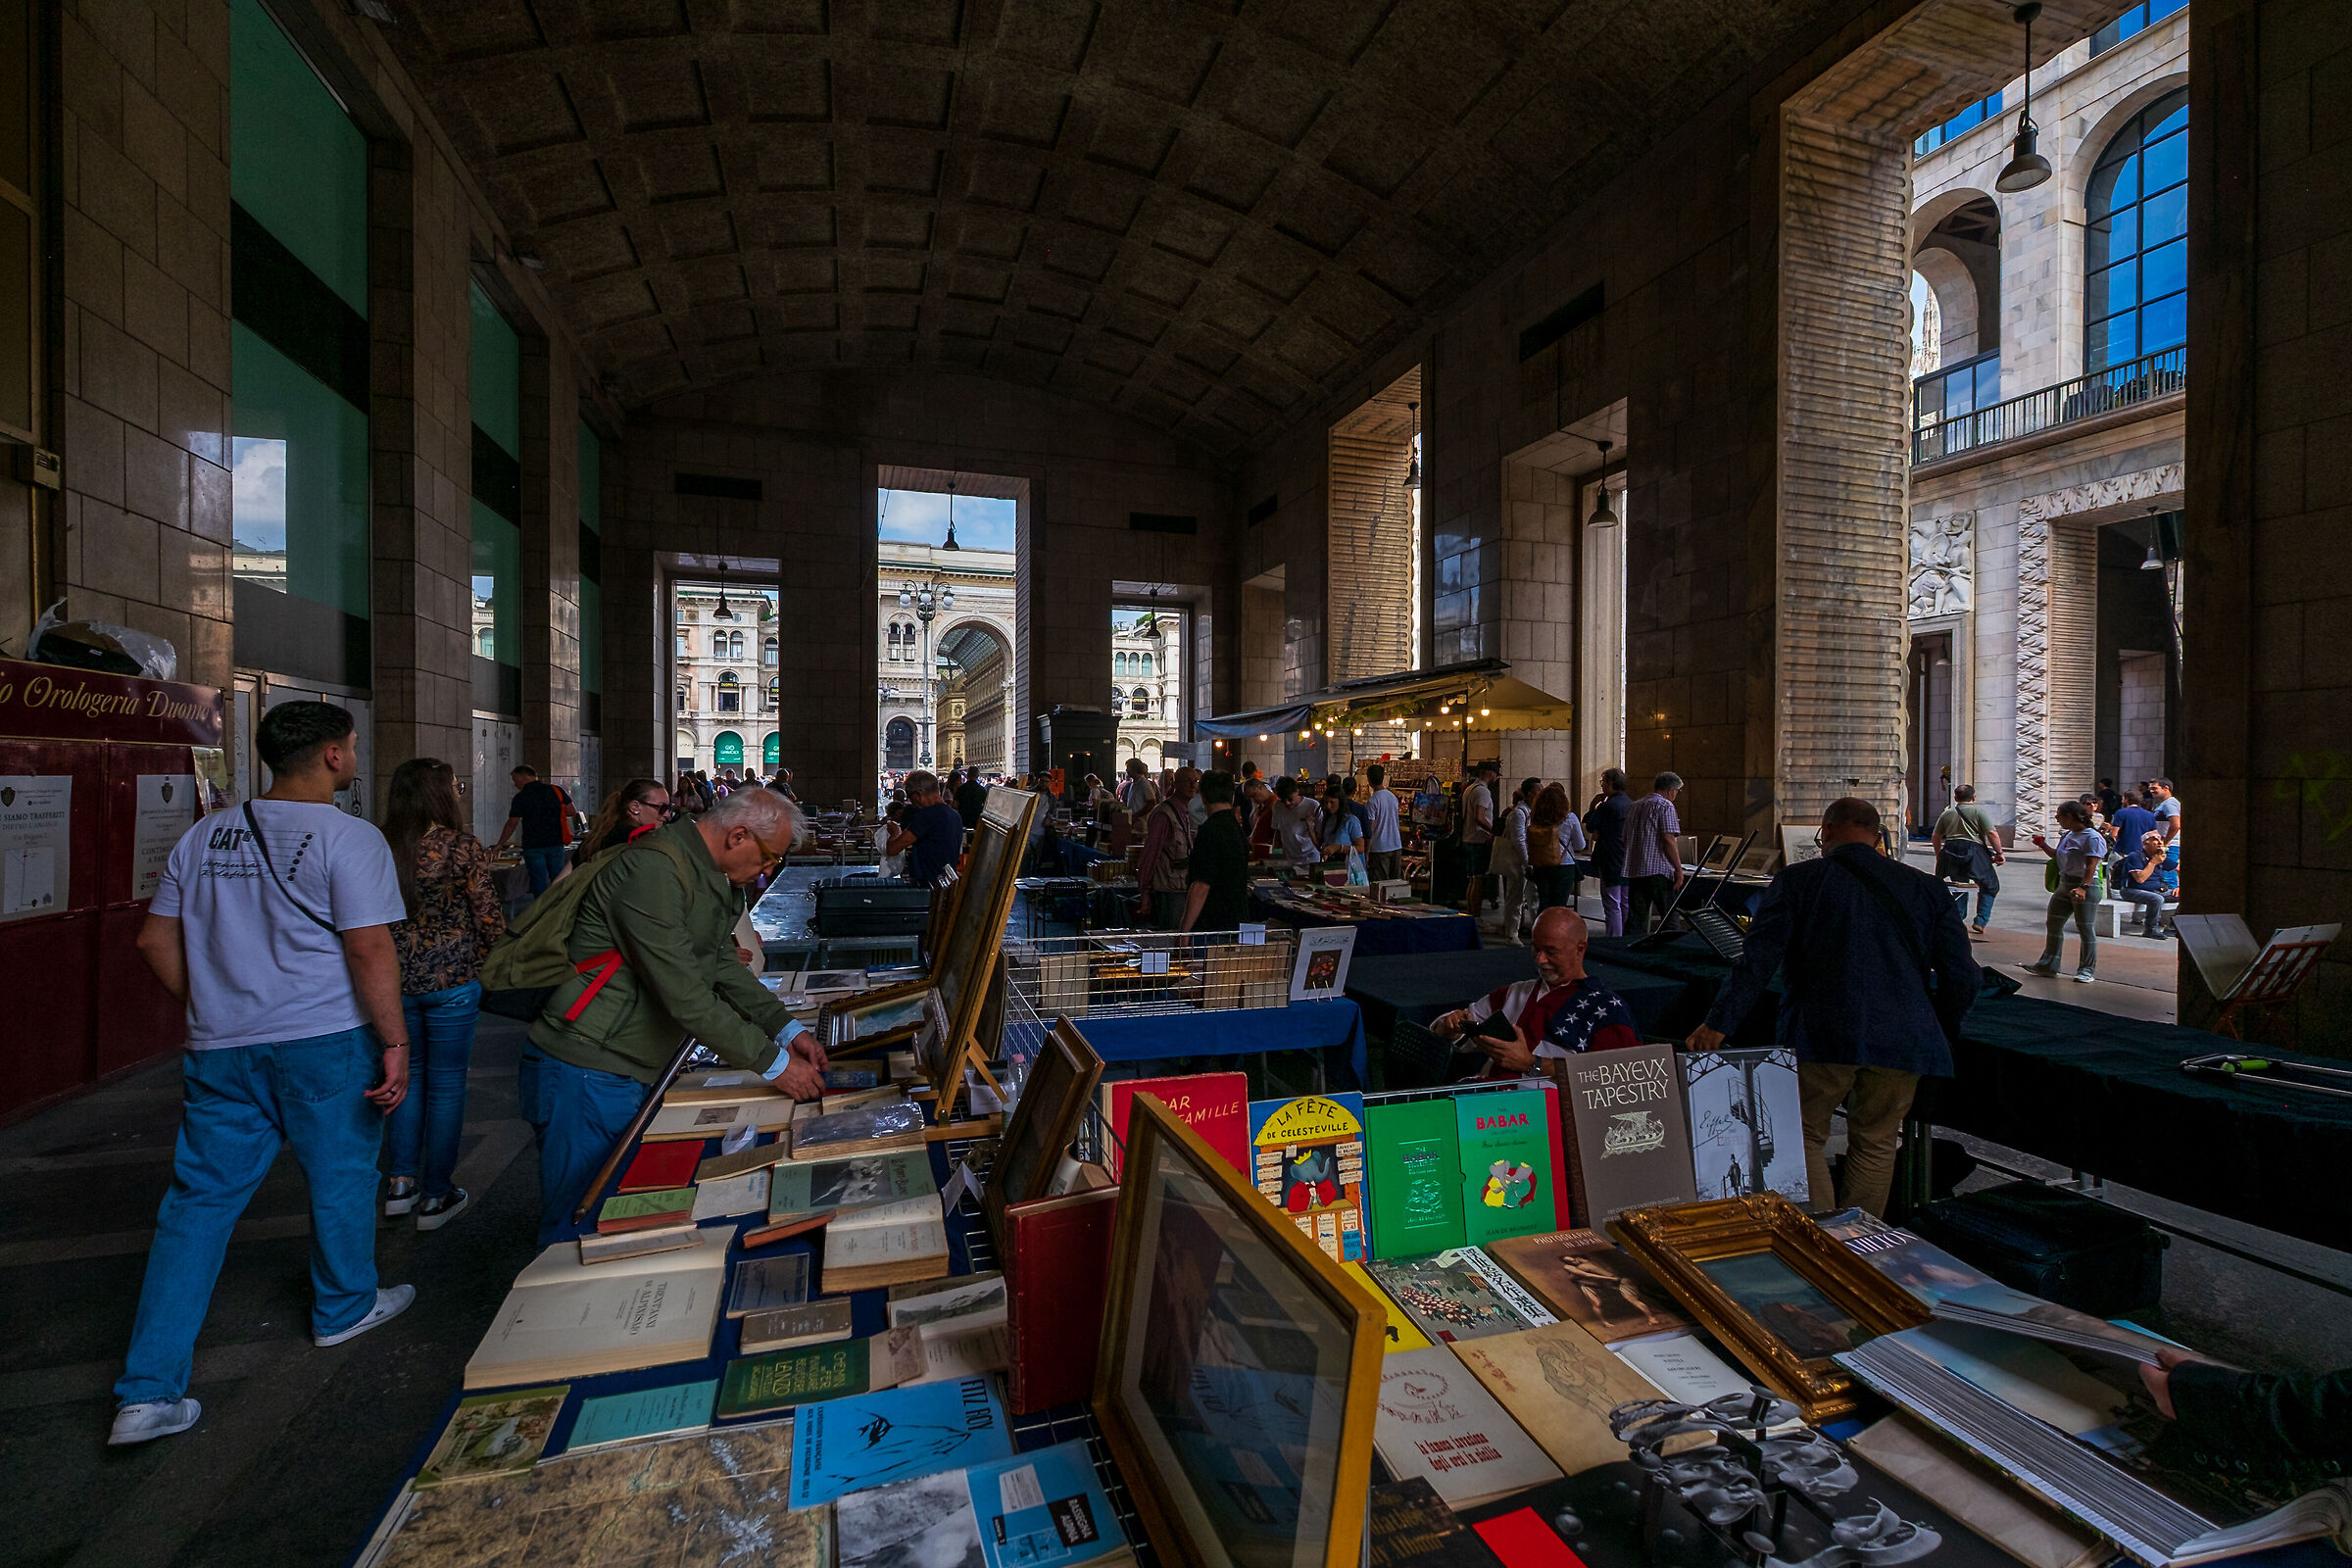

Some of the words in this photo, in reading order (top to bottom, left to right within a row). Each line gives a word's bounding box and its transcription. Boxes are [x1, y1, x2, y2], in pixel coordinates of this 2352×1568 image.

[23, 676, 140, 718] Orologeria
[146, 690, 211, 721] Duomo
[29, 811, 65, 820] TRASFERITI
[1577, 1069, 1601, 1084] THE
[1582, 1079, 1669, 1110] TAPESTRY
[1276, 1111, 1293, 1127] LA
[1296, 1099, 1339, 1119] FÊTE
[1476, 1113, 1530, 1129] BABAR
[1696, 1109, 1733, 1142] Eiffel
[1281, 1122, 1348, 1138] CELESTEVILLE
[1533, 1231, 1594, 1245] PHOTOGRAPHY
[1576, 1237, 1603, 1248] JAPAN
[1844, 1230, 1919, 1255] MILTON
[1461, 1247, 1547, 1319] 浮世絵名作選集
[630, 1288, 653, 1336] ALPINISMO
[774, 1359, 794, 1396] LANZO
[821, 1370, 834, 1388] FER
[832, 1349, 847, 1388] CHEMIN
[960, 1378, 988, 1406] FITZ
[965, 1408, 994, 1431] ROY
[814, 1439, 823, 1471] FRANÇAISE
[1414, 1441, 1430, 1456] la
[1424, 1440, 1455, 1453] famosa
[1448, 1432, 1490, 1449] invasione
[1427, 1454, 1452, 1473] degli
[1448, 1451, 1469, 1468] orsi
[1463, 1450, 1479, 1465] in
[1475, 1446, 1503, 1463] sicilia
[1058, 1513, 1080, 1544] ALPINA
[1067, 1497, 1095, 1541] RASSEGNA
